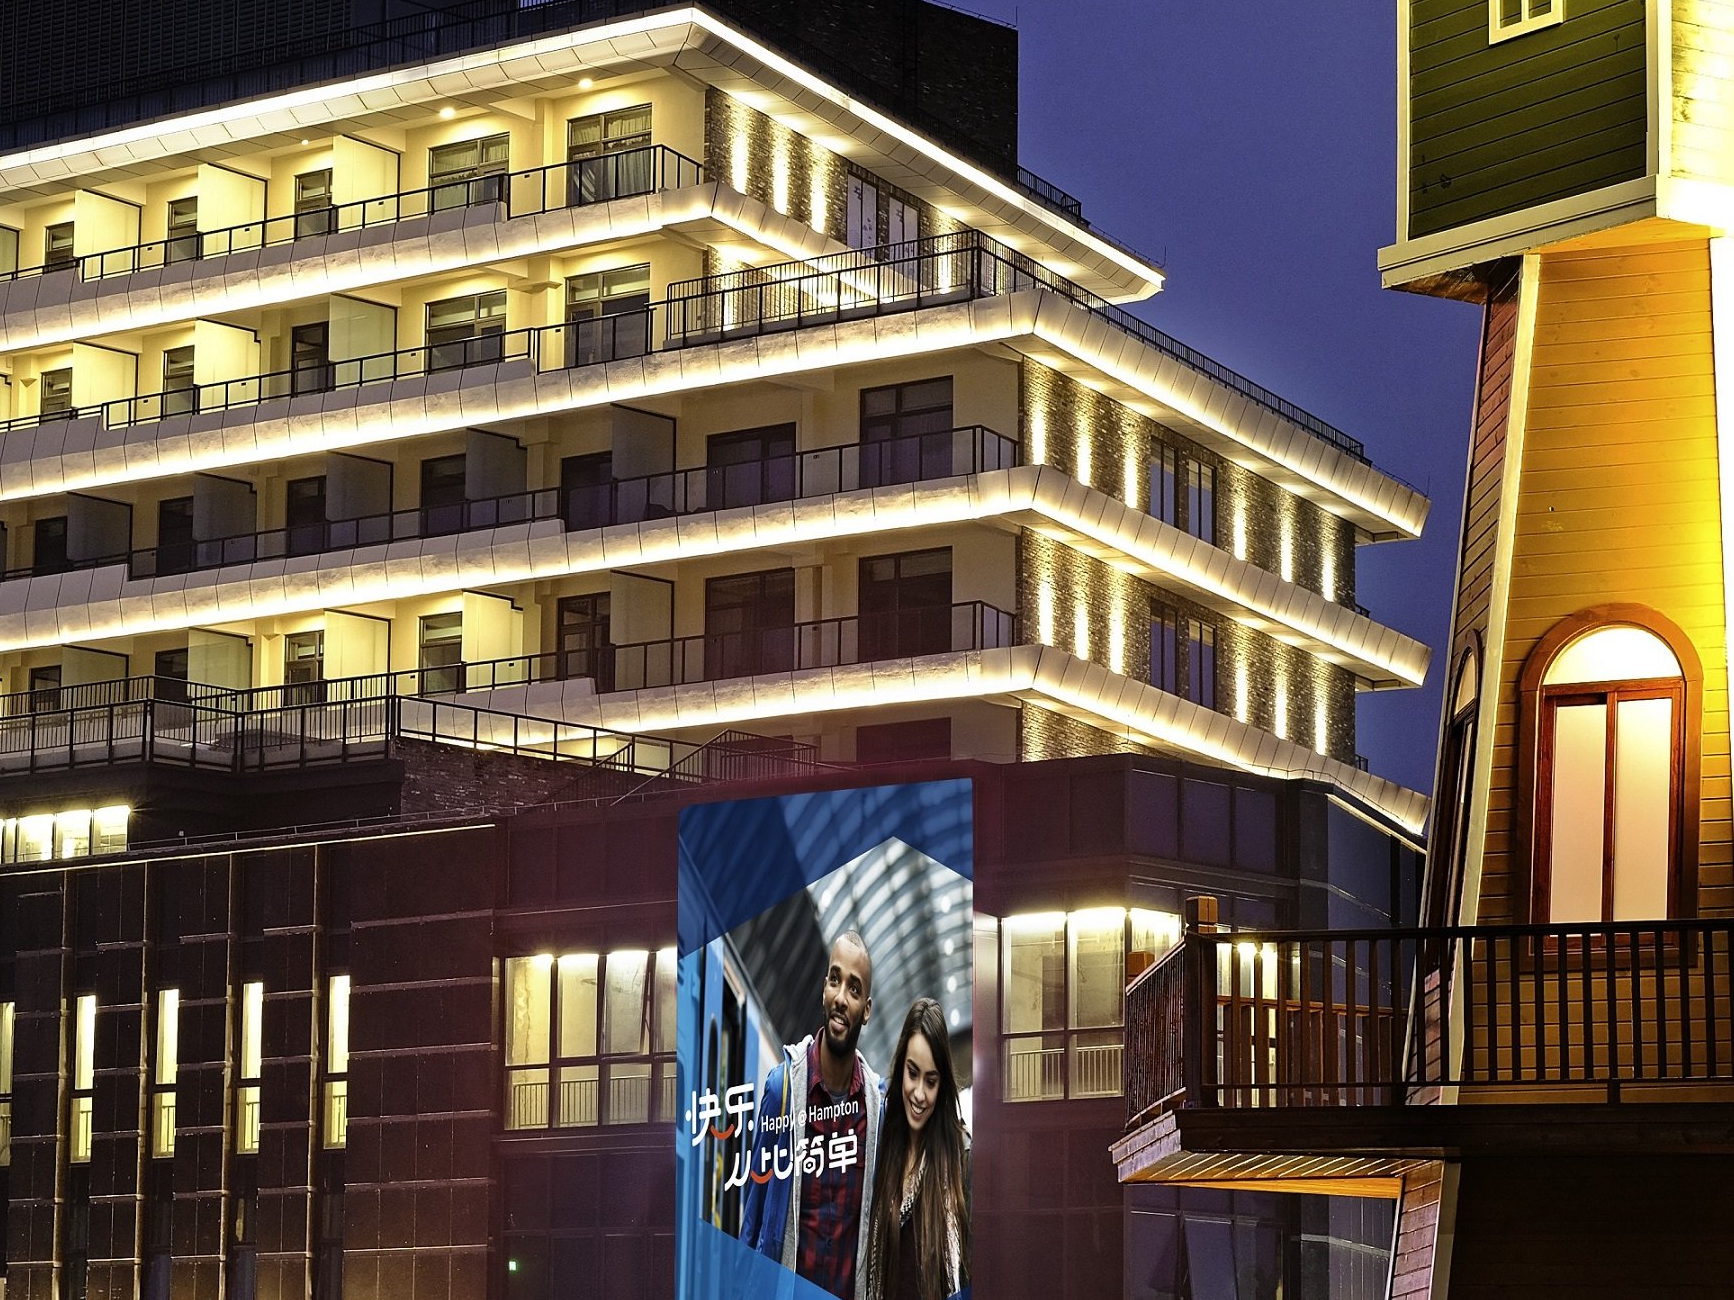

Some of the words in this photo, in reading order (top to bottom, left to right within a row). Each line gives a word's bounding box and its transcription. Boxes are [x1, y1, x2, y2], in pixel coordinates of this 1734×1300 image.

[685, 1083, 755, 1147] 快乐
[761, 1114, 796, 1135] Happy
[809, 1100, 859, 1123] Hampton
